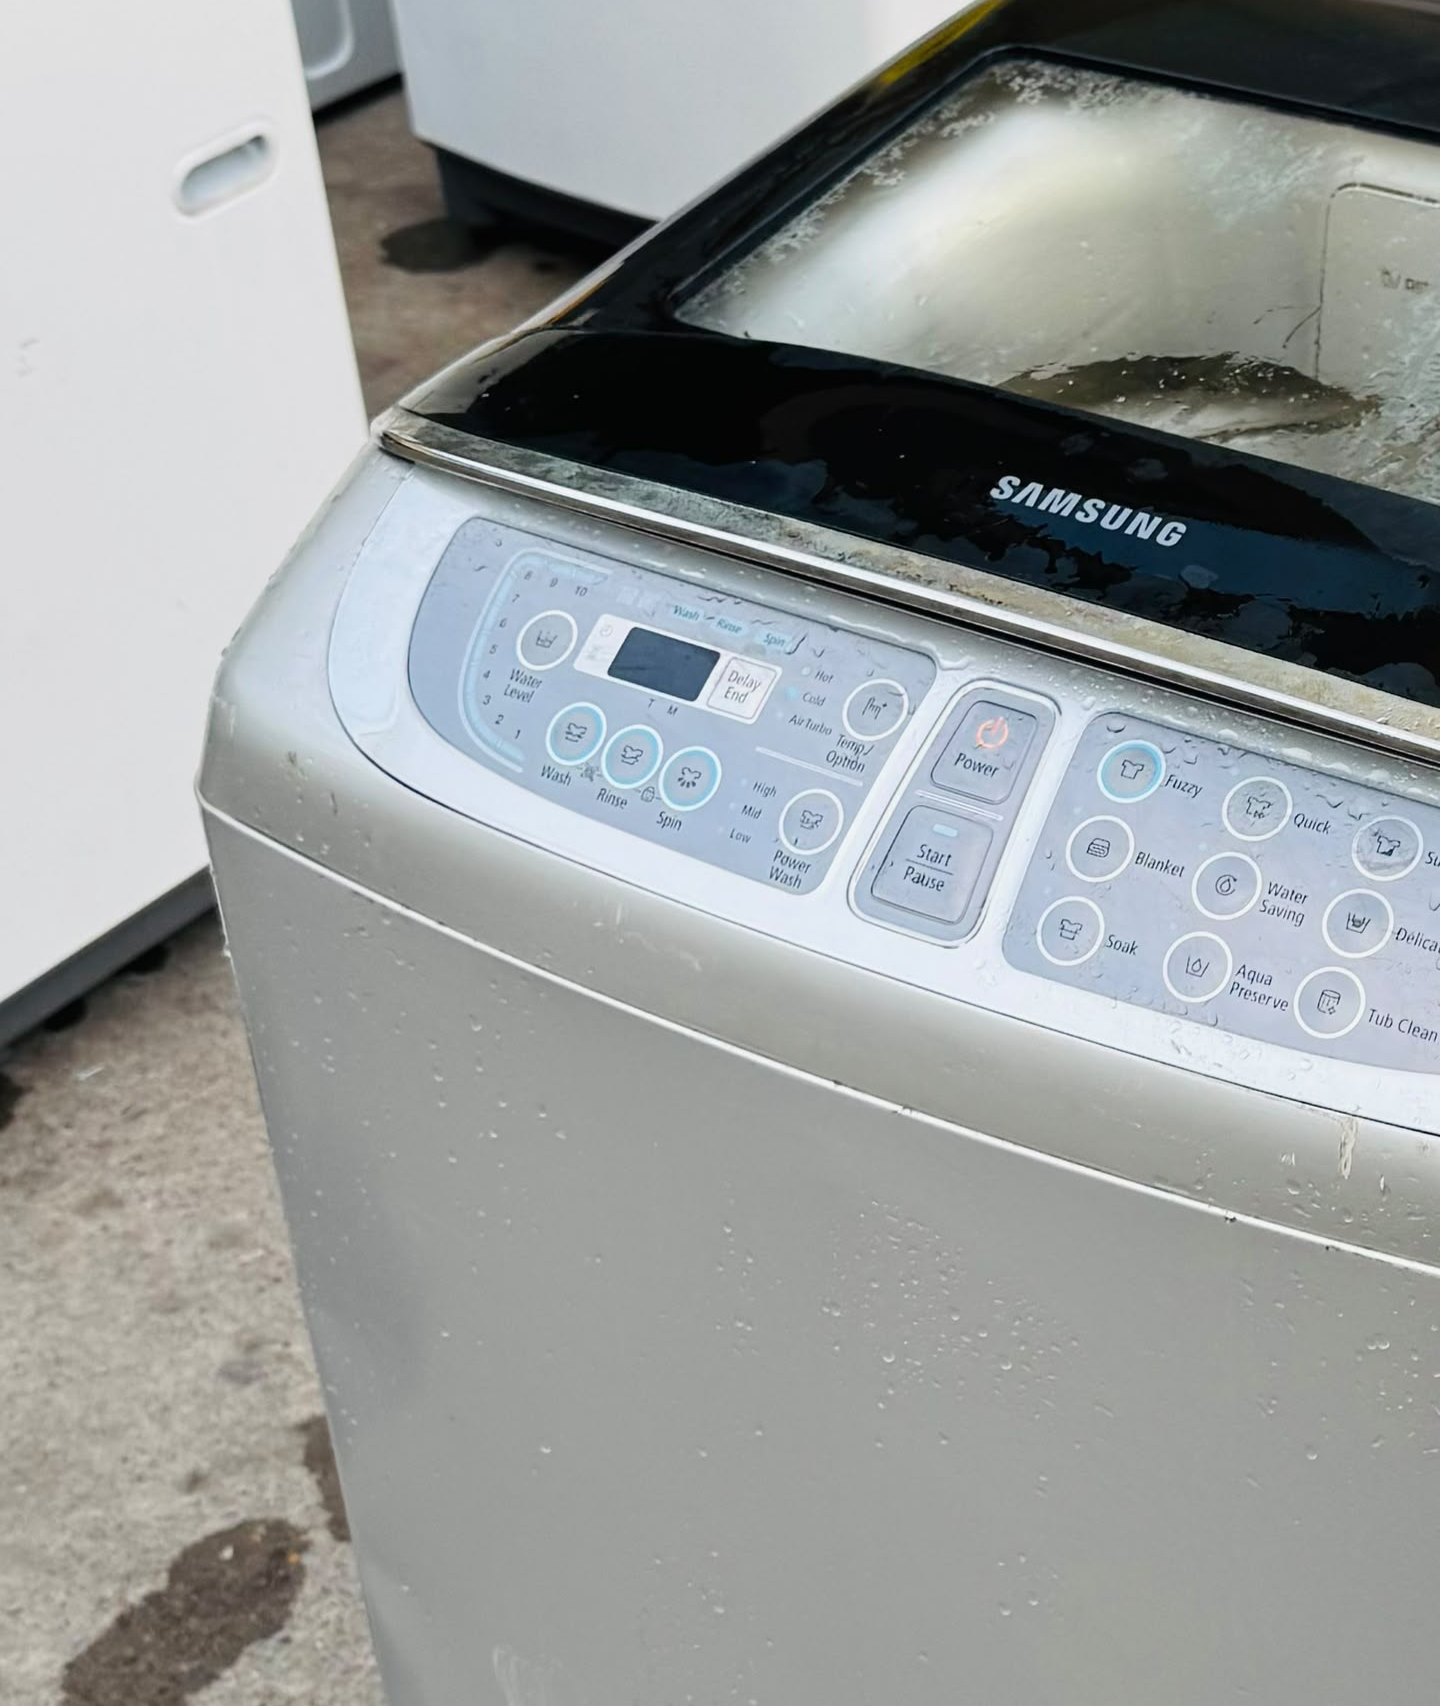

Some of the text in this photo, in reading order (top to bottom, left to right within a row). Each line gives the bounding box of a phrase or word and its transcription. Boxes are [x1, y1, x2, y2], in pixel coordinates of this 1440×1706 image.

[990, 475, 1187, 547] SAMSUNG
[549, 577, 559, 588] 9
[575, 585, 588, 597] 10
[511, 593, 520, 603] 7
[672, 604, 700, 621] Wash
[499, 618, 507, 629] 6
[715, 618, 743, 635] Rinse
[489, 644, 498, 655] 5
[762, 632, 786, 647] Spin
[483, 670, 491, 680] 4
[509, 668, 542, 689] Water
[727, 670, 761, 693] Delay
[814, 671, 834, 684] Hot
[482, 695, 491, 706] 3
[503, 684, 535, 703] Level
[724, 687, 748, 704] End
[802, 692, 826, 707] Cold
[495, 714, 504, 725] 2
[805, 718, 832, 735] Turbo
[514, 729, 521, 740] 1
[826, 750, 865, 773] Option
[954, 752, 999, 778] Power
[540, 765, 572, 786] Wash
[753, 782, 777, 798] High
[1164, 773, 1203, 799] Fuzzy
[596, 788, 628, 809] Rinse
[656, 811, 682, 831] Spin
[741, 805, 762, 819] Mid
[1293, 812, 1332, 835] Quick
[729, 828, 751, 843] Low
[773, 849, 811, 874] Power
[917, 843, 952, 867] Start
[1134, 851, 1185, 878] Blanket
[769, 866, 802, 889] Wash
[903, 865, 944, 892] Pause
[1268, 881, 1309, 905] Water
[1259, 899, 1305, 928] Saving
[1105, 934, 1139, 956] Soak
[1236, 964, 1273, 987] Aqua
[1229, 982, 1290, 1012] Preserve
[1367, 1008, 1439, 1042] Tub Clean
